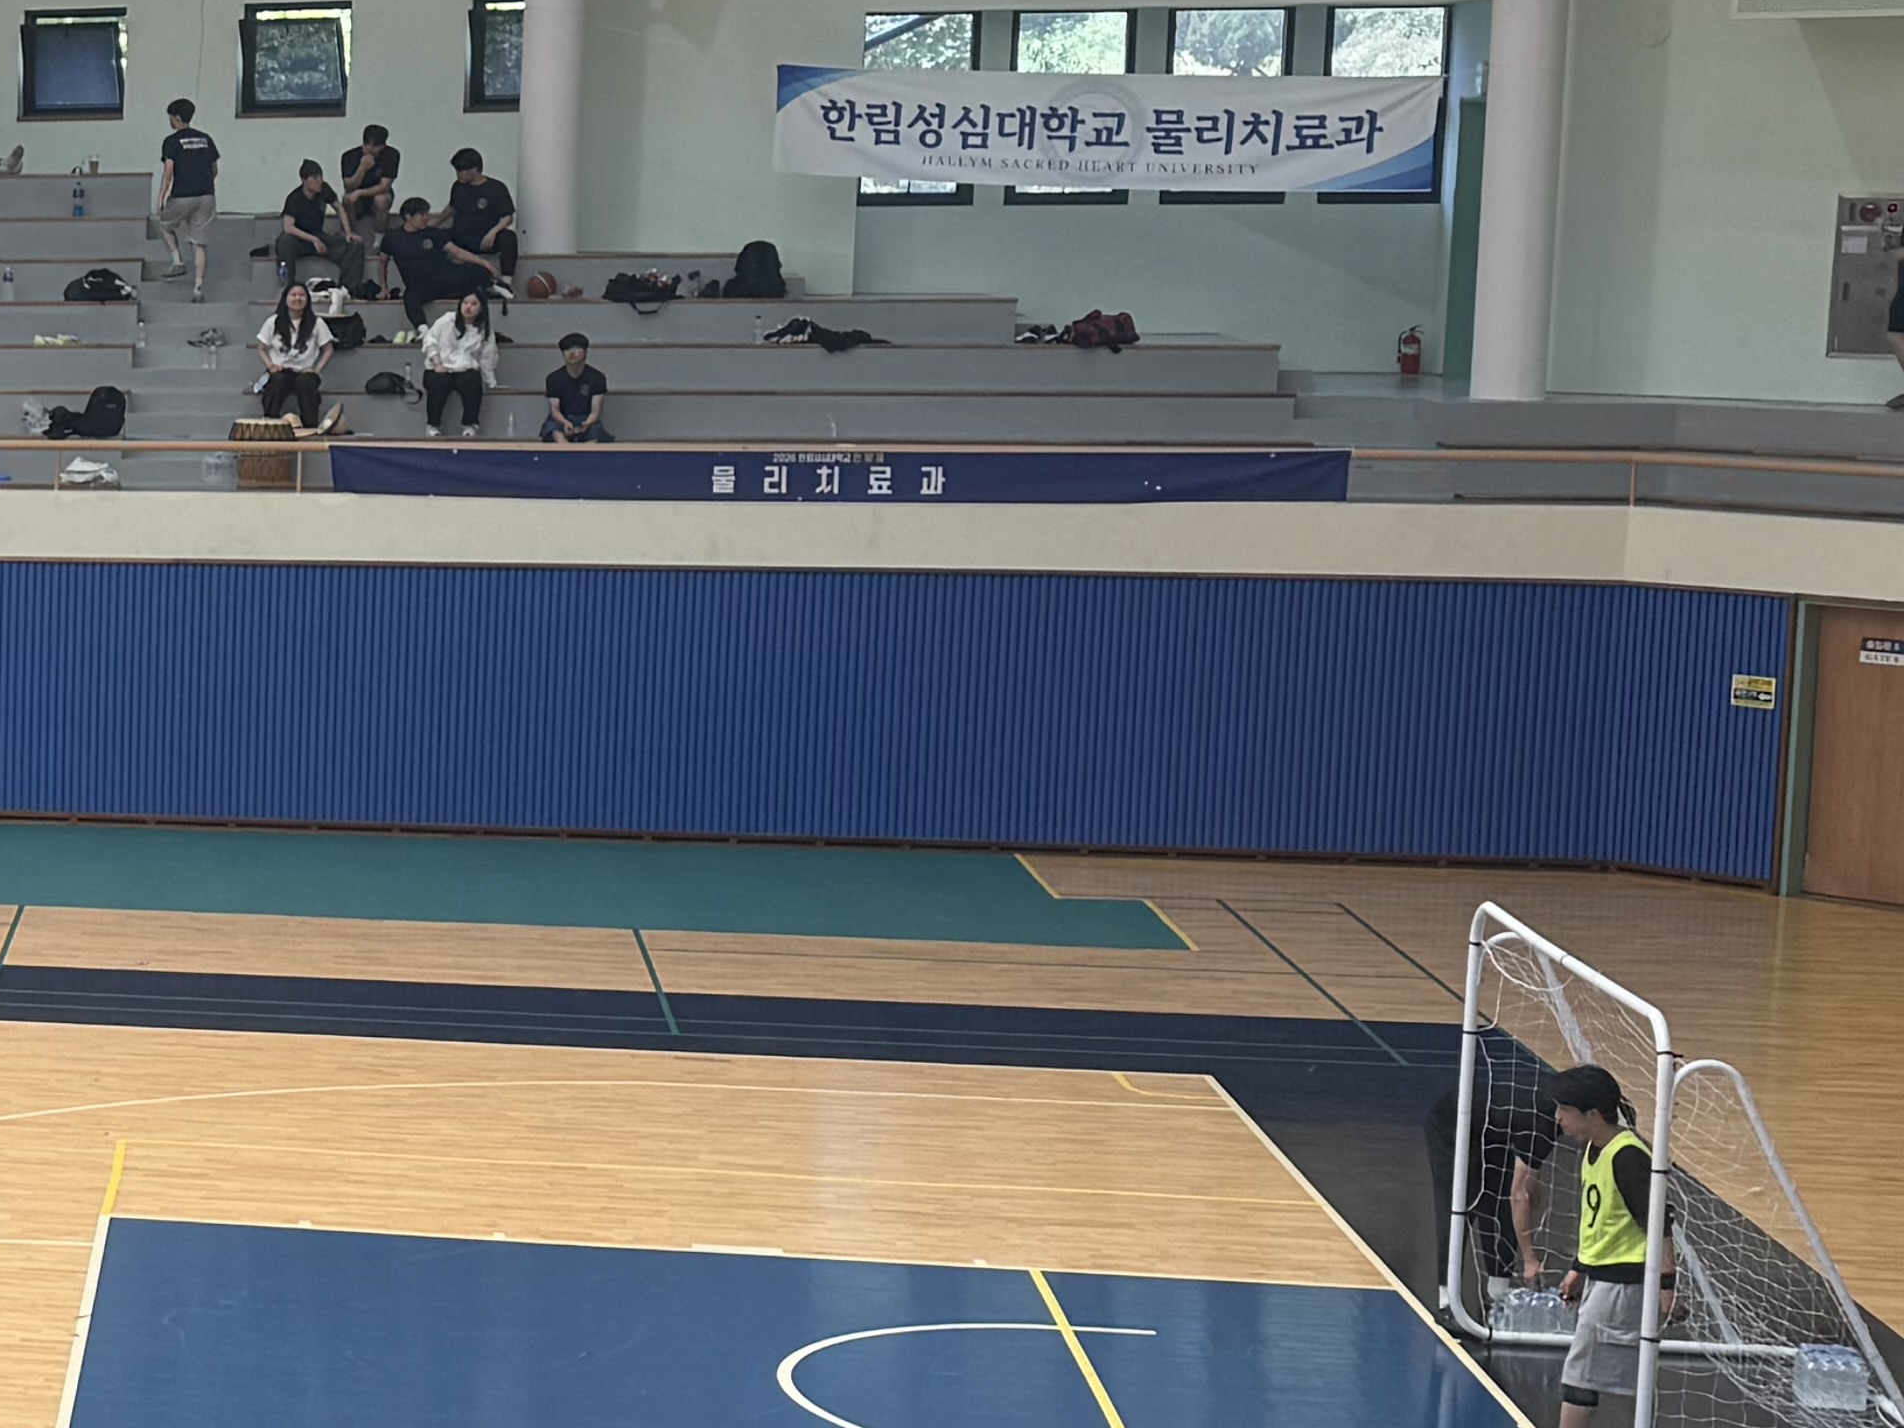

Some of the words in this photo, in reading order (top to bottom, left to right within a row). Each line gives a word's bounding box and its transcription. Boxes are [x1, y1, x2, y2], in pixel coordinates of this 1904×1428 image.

[820, 99, 1130, 153] 한림성심대학교
[1145, 107, 1384, 156] 물리치료과
[922, 156, 991, 169] HALLYM
[1001, 158, 1075, 171] SACRED
[1078, 160, 1136, 172] HEART
[1146, 161, 1258, 175] UNIVERSITY
